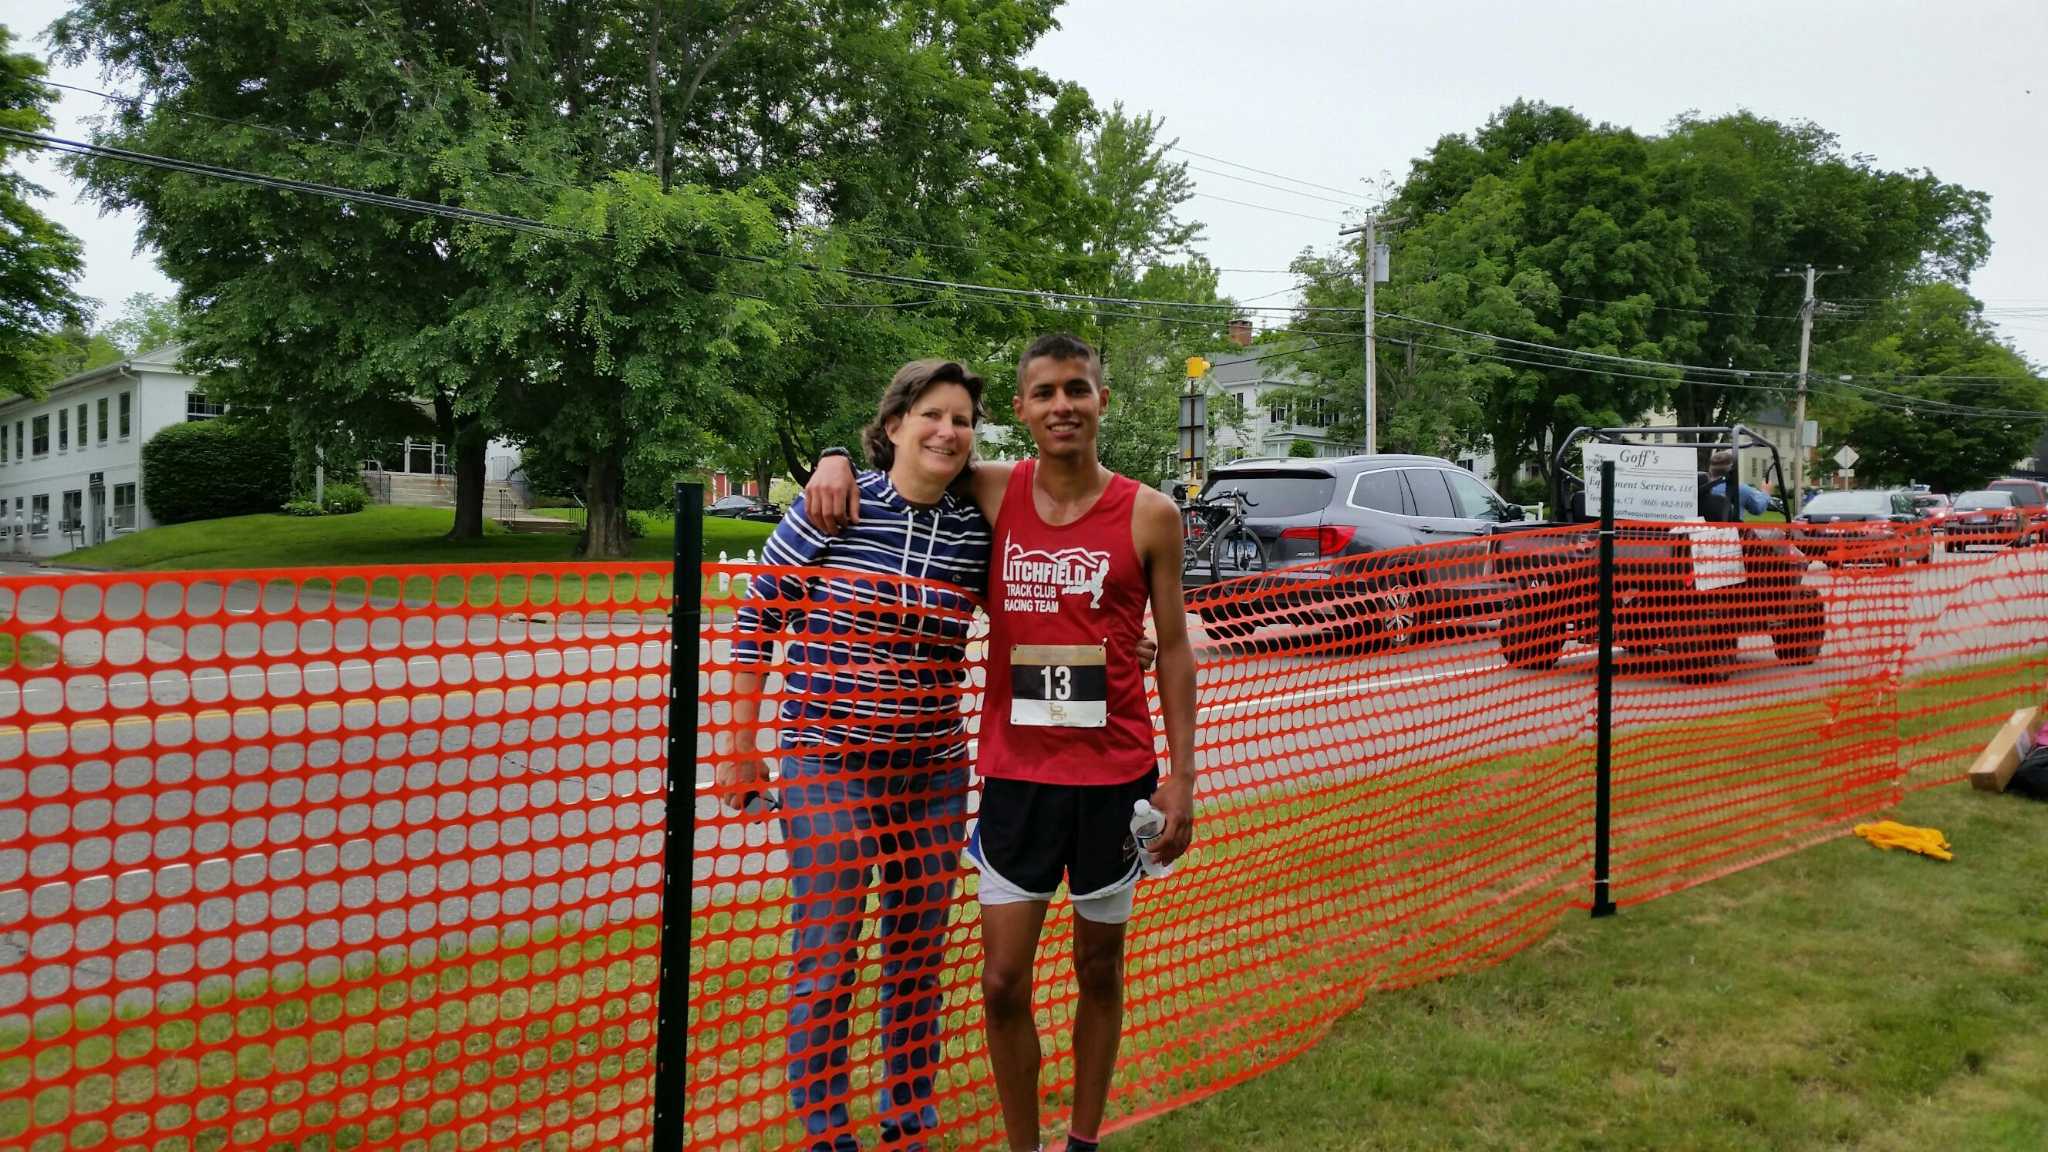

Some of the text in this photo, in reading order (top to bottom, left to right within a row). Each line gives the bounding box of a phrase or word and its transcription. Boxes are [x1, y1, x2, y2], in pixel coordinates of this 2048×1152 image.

[1619, 448, 1660, 468] Goff's
[1640, 480, 1677, 492] Service,
[1003, 546, 1087, 586] LITCHFIELD
[1006, 584, 1057, 599] TRACK CLUB
[1004, 599, 1059, 613] RACING TEAM
[1041, 665, 1071, 700] 13
